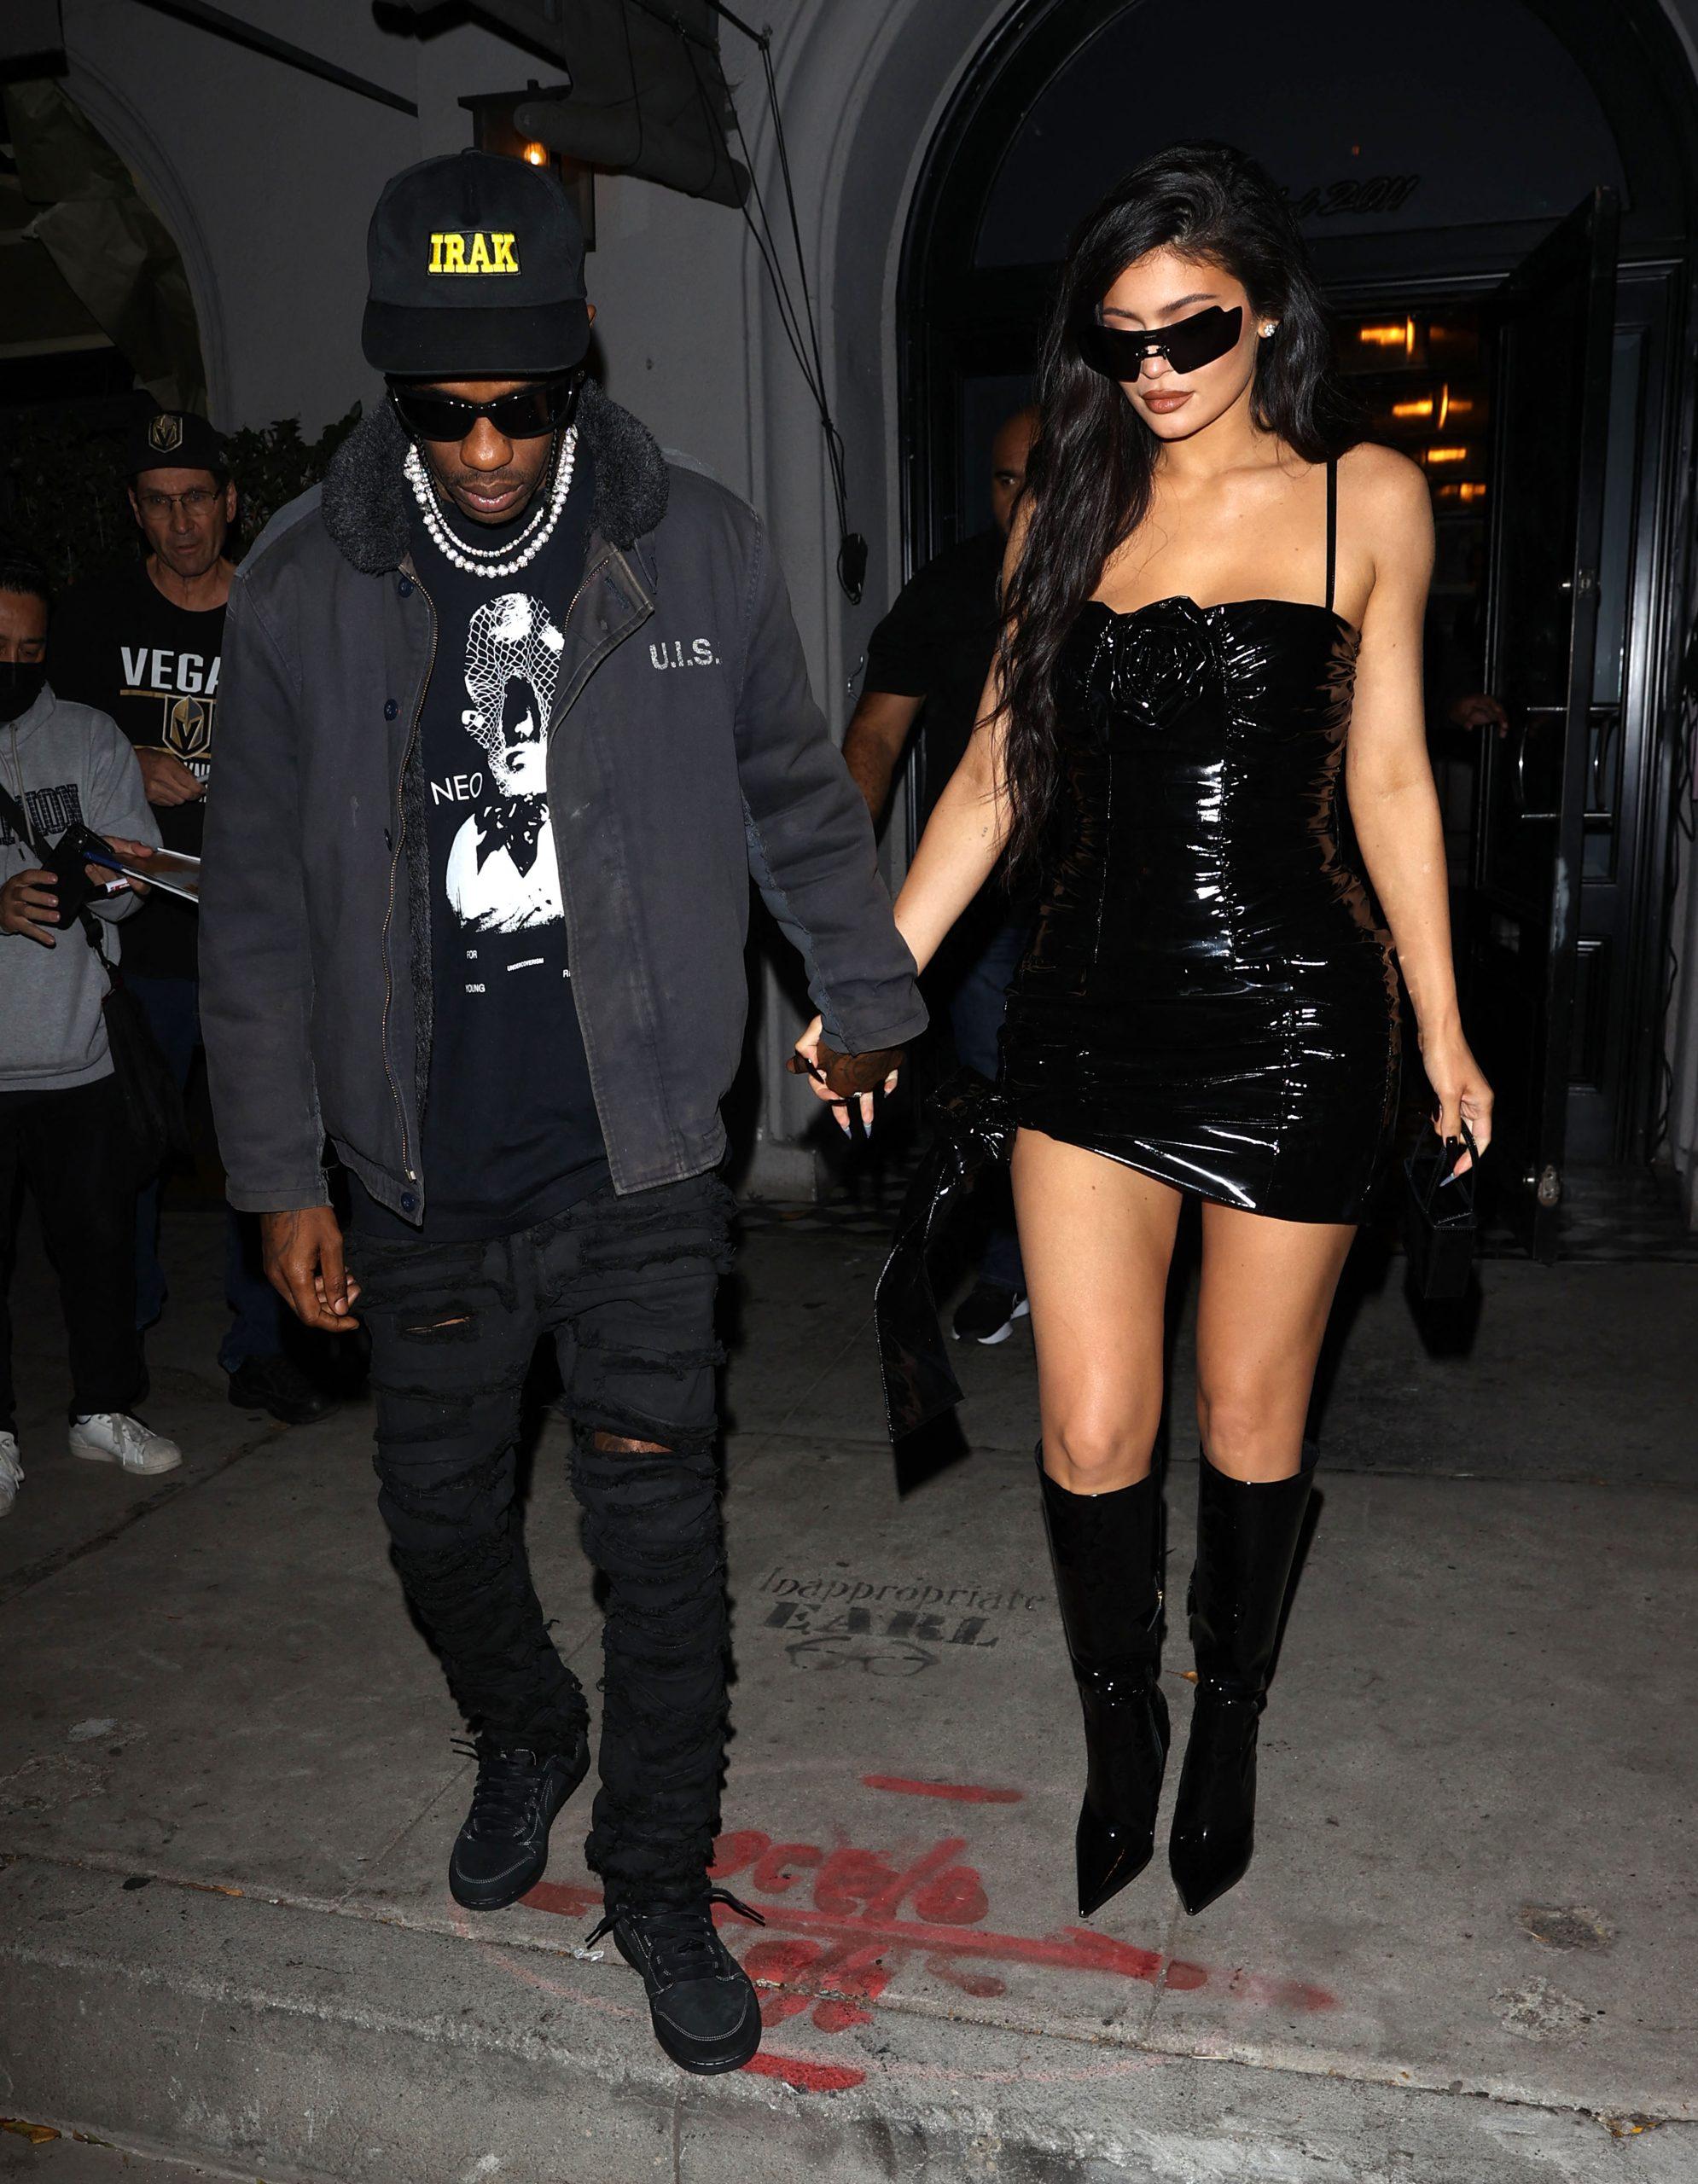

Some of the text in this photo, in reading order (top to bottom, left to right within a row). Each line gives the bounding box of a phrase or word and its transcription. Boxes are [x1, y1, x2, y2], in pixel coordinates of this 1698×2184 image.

[428, 232, 519, 274] IRAK
[648, 638, 721, 670] U.I.S.
[430, 772, 484, 805] NEO
[466, 950, 478, 959] FOR
[465, 983, 486, 993] YOUNG
[759, 1566, 1047, 1612] Inappropriate
[764, 1600, 1000, 1648] EARL
